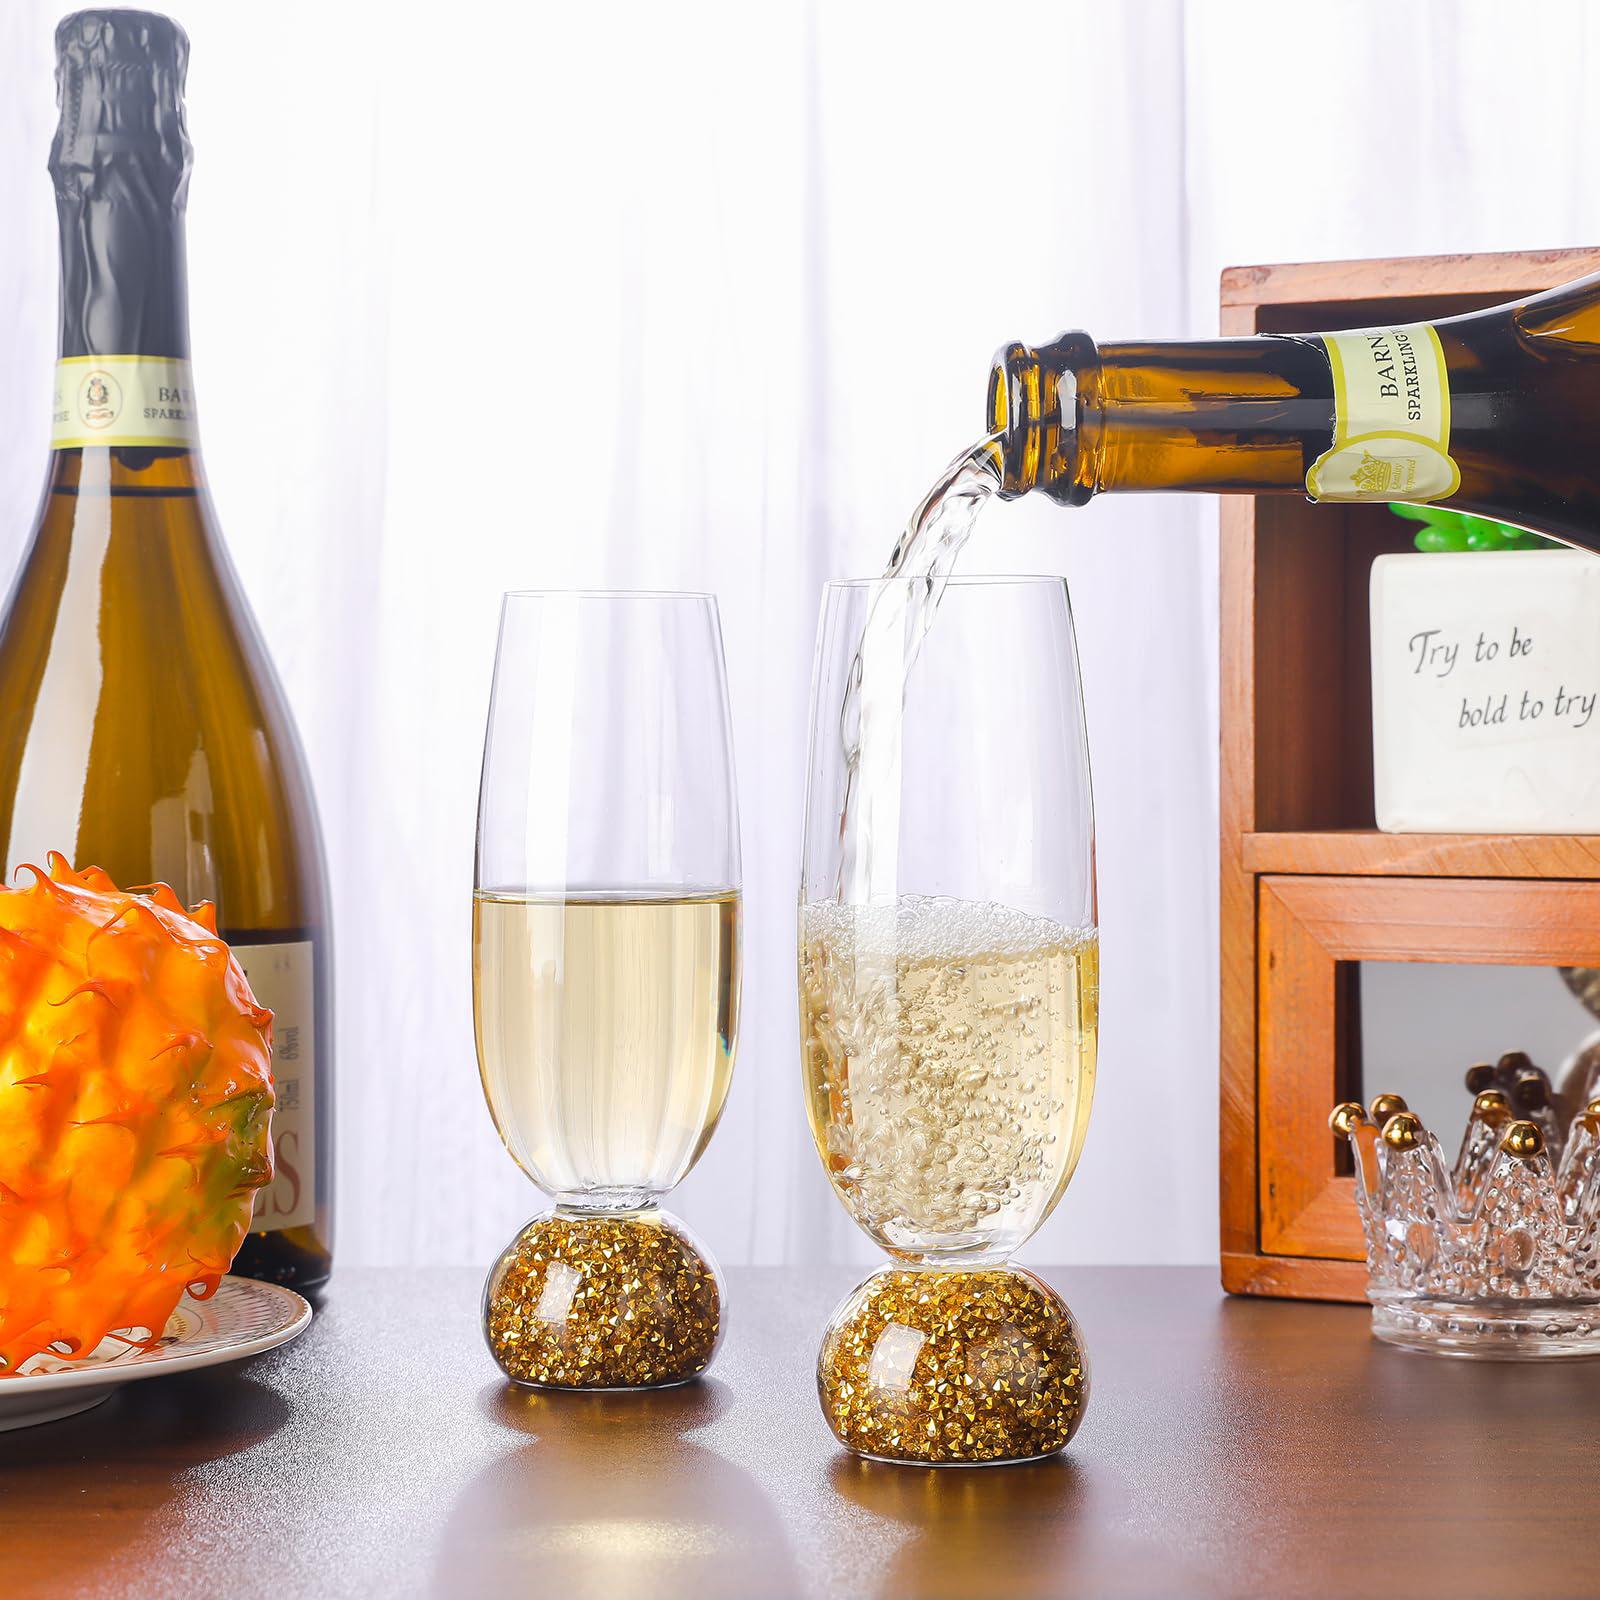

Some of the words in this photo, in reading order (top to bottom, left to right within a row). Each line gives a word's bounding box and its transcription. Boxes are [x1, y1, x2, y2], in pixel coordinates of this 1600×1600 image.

[1395, 334, 1421, 420] SPARKLING
[1408, 629, 1459, 678] Try
[1475, 632, 1499, 663] to
[1509, 626, 1534, 657] be
[1458, 693, 1508, 728] bold
[1520, 690, 1544, 721] to
[1555, 684, 1597, 728] try
